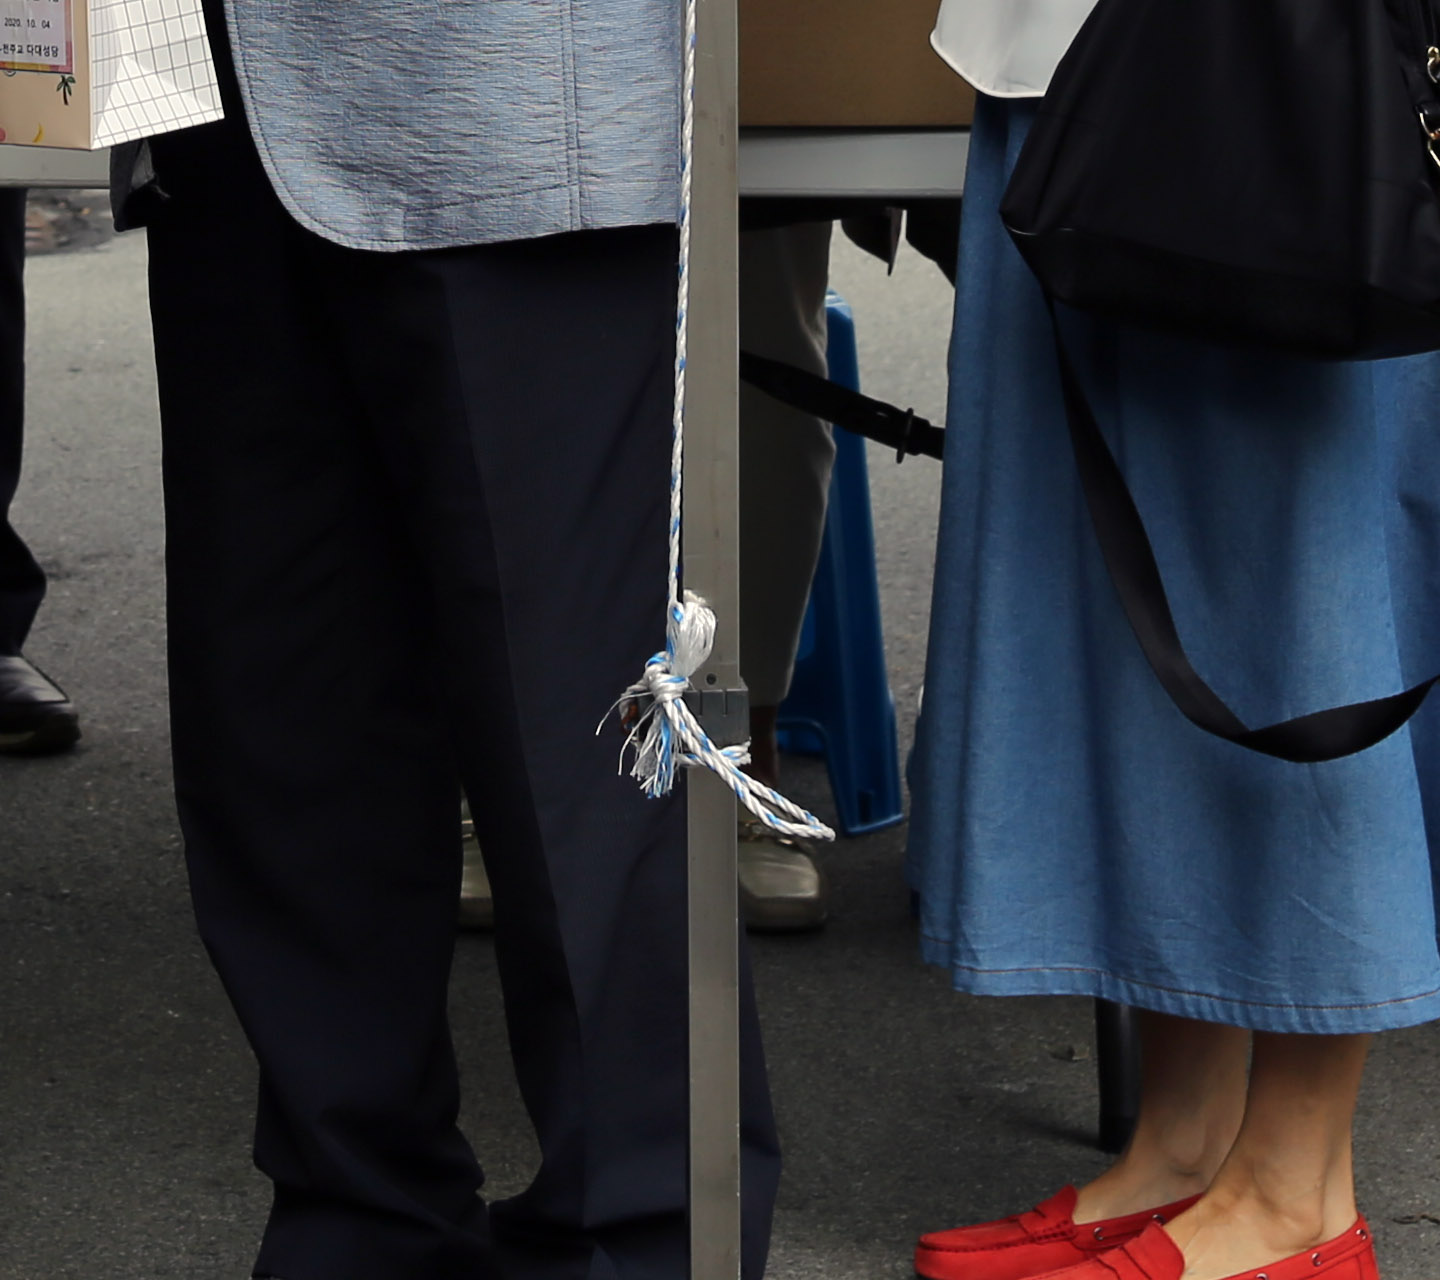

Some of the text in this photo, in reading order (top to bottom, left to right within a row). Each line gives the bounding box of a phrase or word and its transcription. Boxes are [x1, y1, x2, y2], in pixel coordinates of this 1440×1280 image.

[4, 17, 51, 29] 2020. 10. 04
[2, 43, 59, 58] 천주교 다대성당
